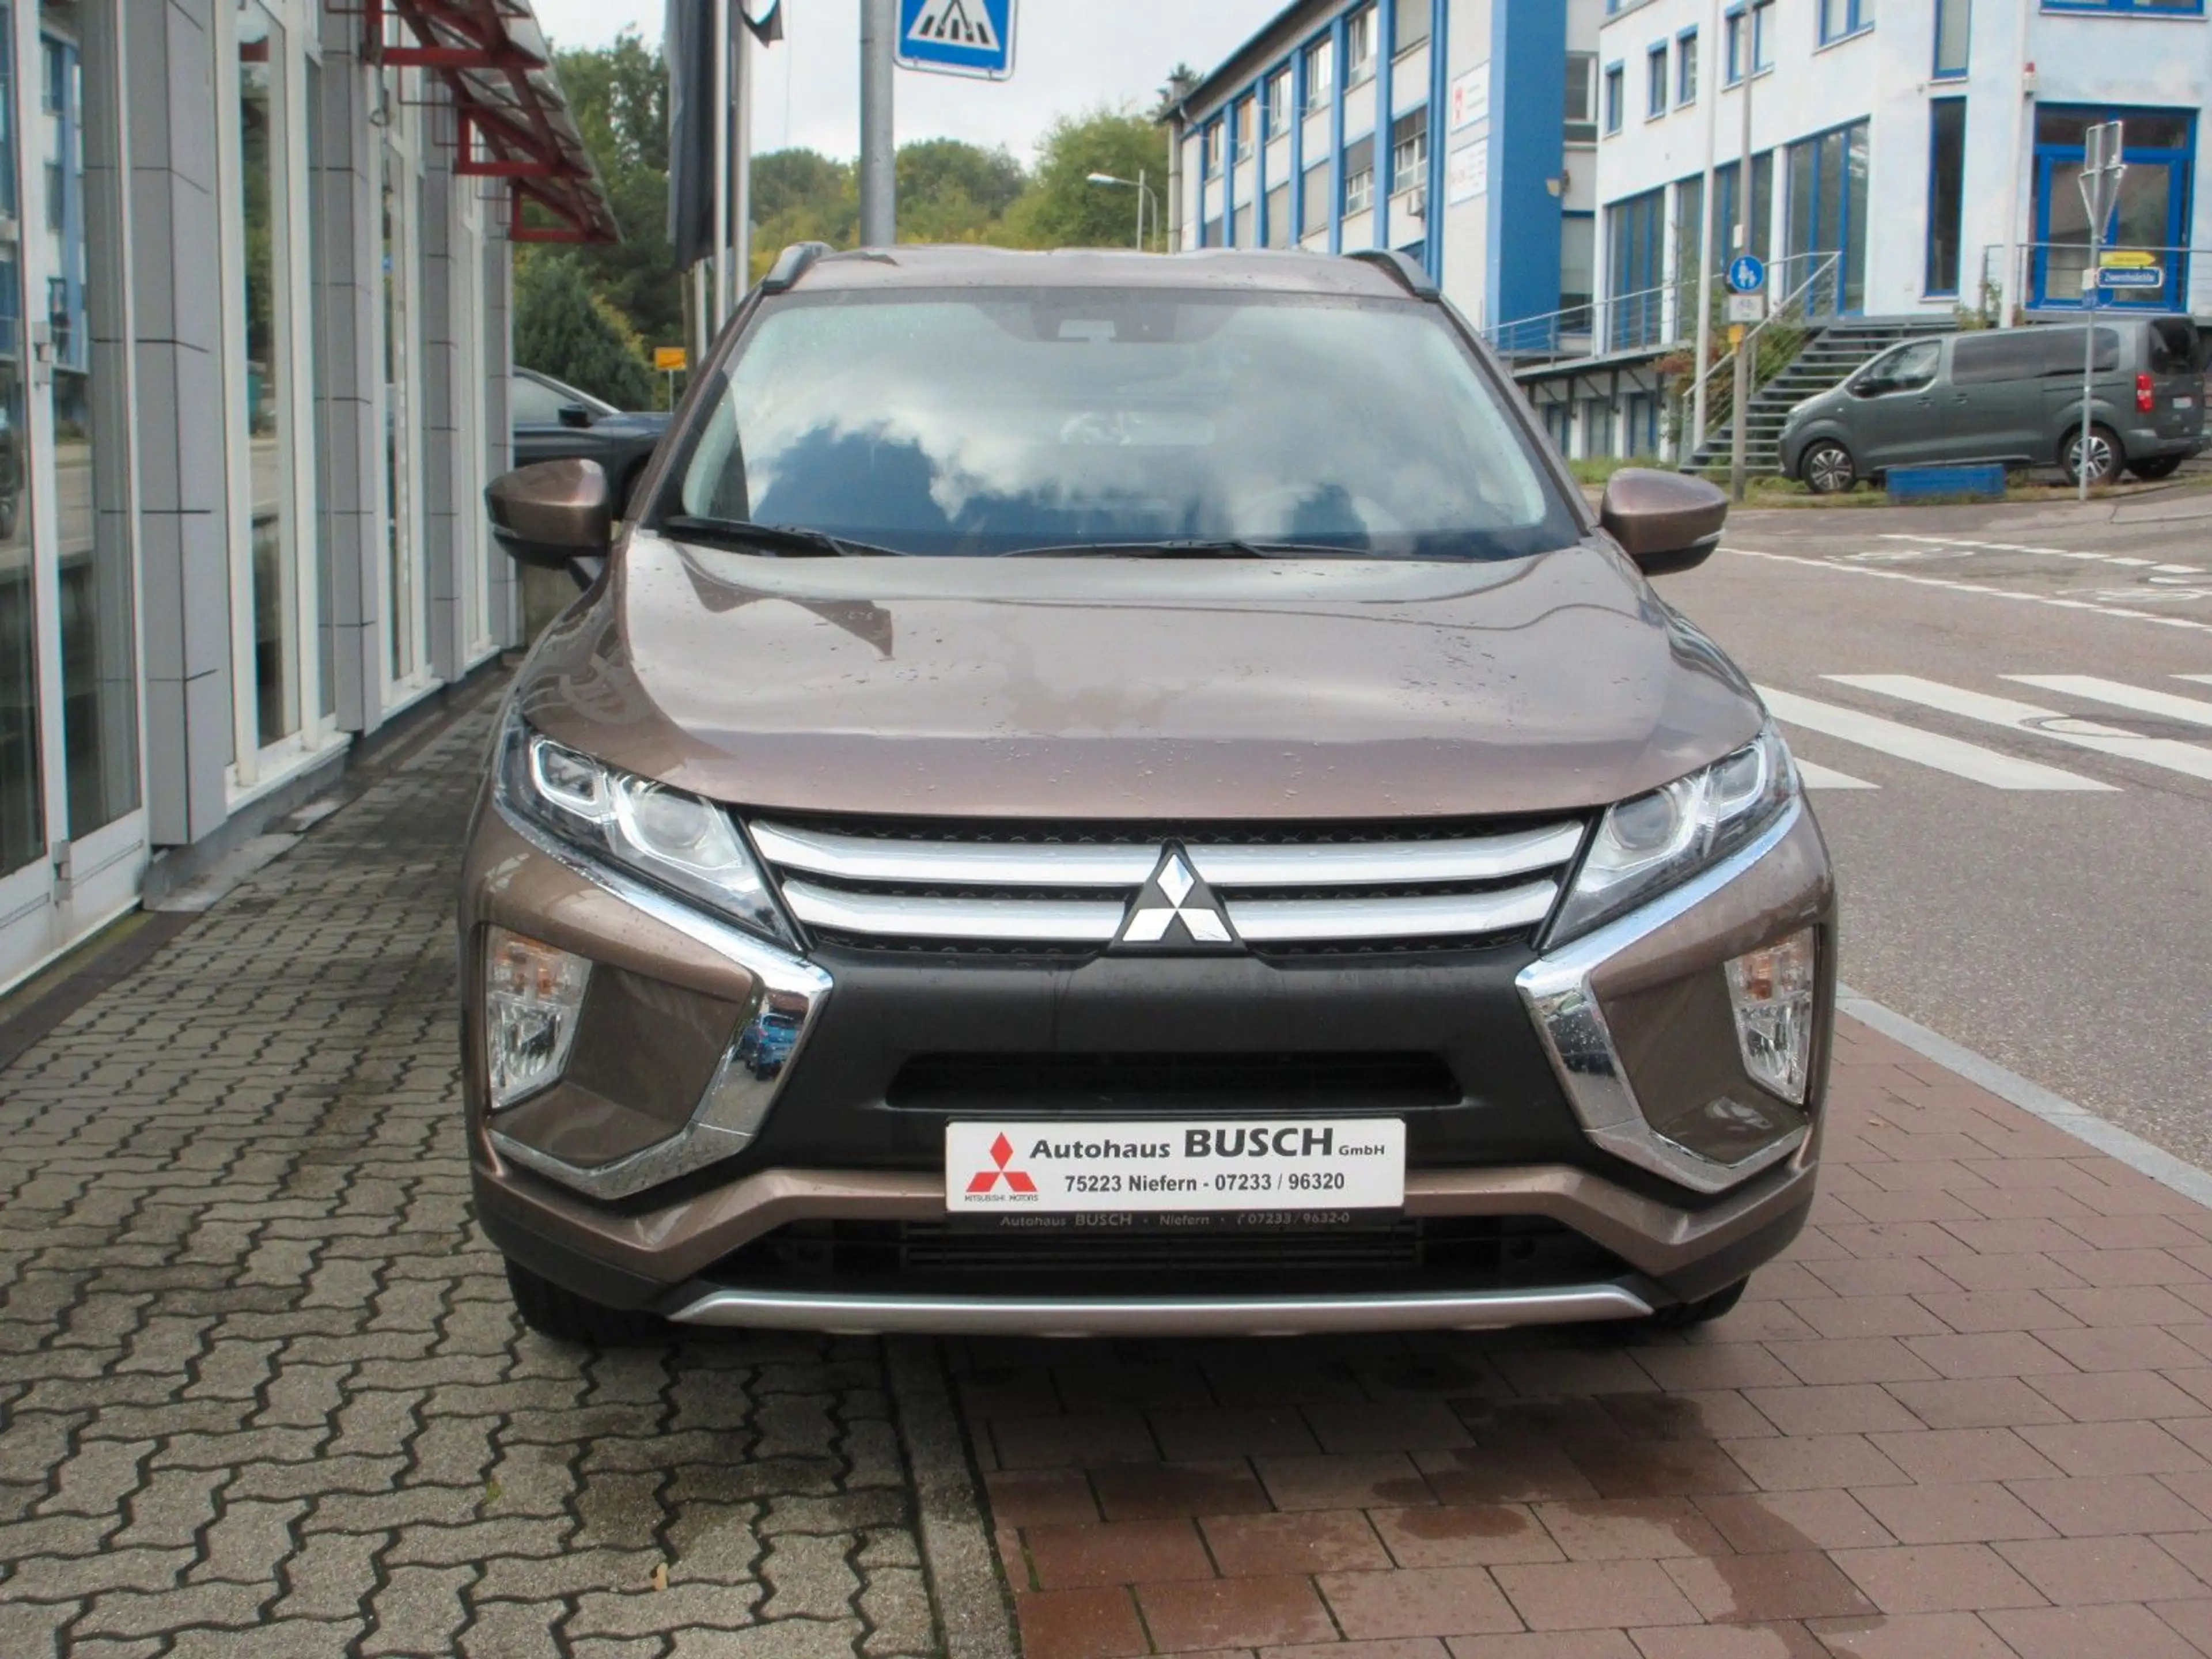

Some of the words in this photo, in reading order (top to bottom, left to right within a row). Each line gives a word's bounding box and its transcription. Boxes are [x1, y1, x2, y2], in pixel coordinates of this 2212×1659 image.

[1029, 1139, 1171, 1159] Autohaus
[1184, 1127, 1334, 1157] BUSCH
[1339, 1144, 1385, 1156] GmbH
[1065, 1175, 1122, 1192] 75223
[1128, 1175, 1197, 1192] Niefern
[1215, 1173, 1271, 1191] 07233
[1288, 1172, 1345, 1190] 96320
[1000, 1215, 1066, 1226] Autohaus
[1075, 1213, 1132, 1226] BUSCH
[1159, 1214, 1210, 1226] Niefern
